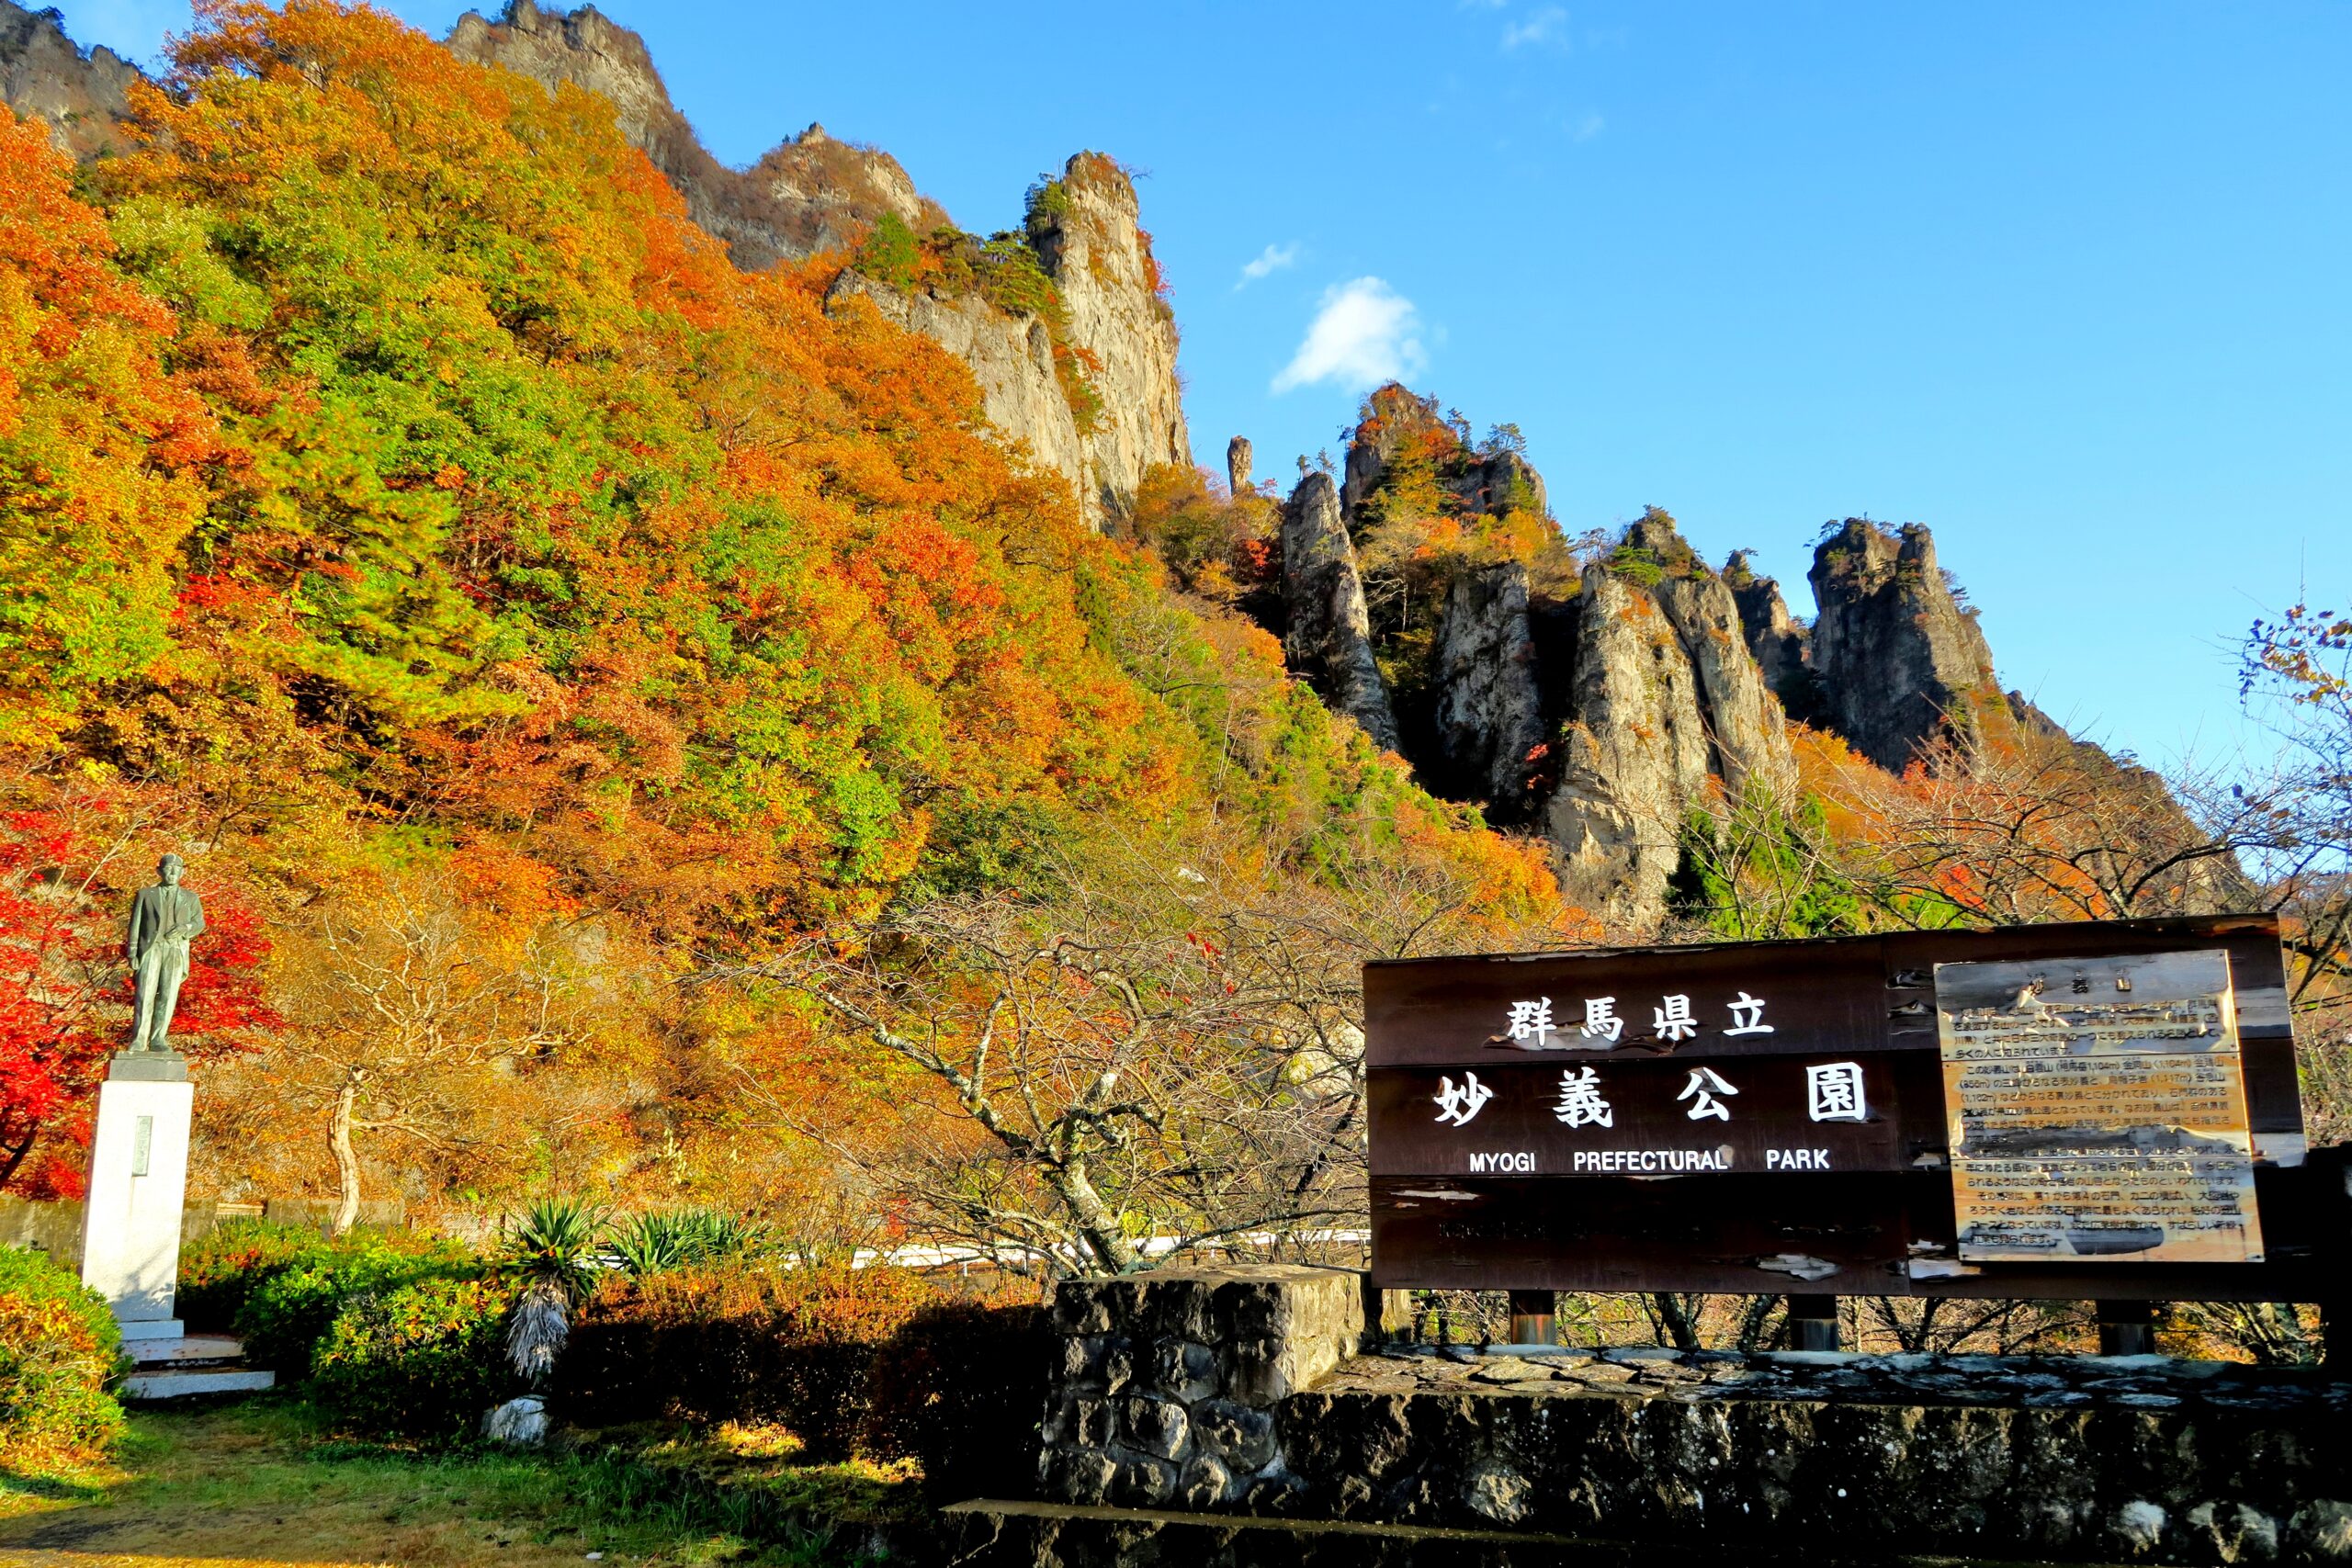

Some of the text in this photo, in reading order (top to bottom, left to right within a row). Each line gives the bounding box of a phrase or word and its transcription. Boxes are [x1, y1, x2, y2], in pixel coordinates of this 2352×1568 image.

[1507, 991, 1775, 1046] 群馬県立
[1433, 1062, 1866, 1128] 妙義公園
[1470, 1148, 1830, 1172] MYOGI PREFECTURAL PARK
